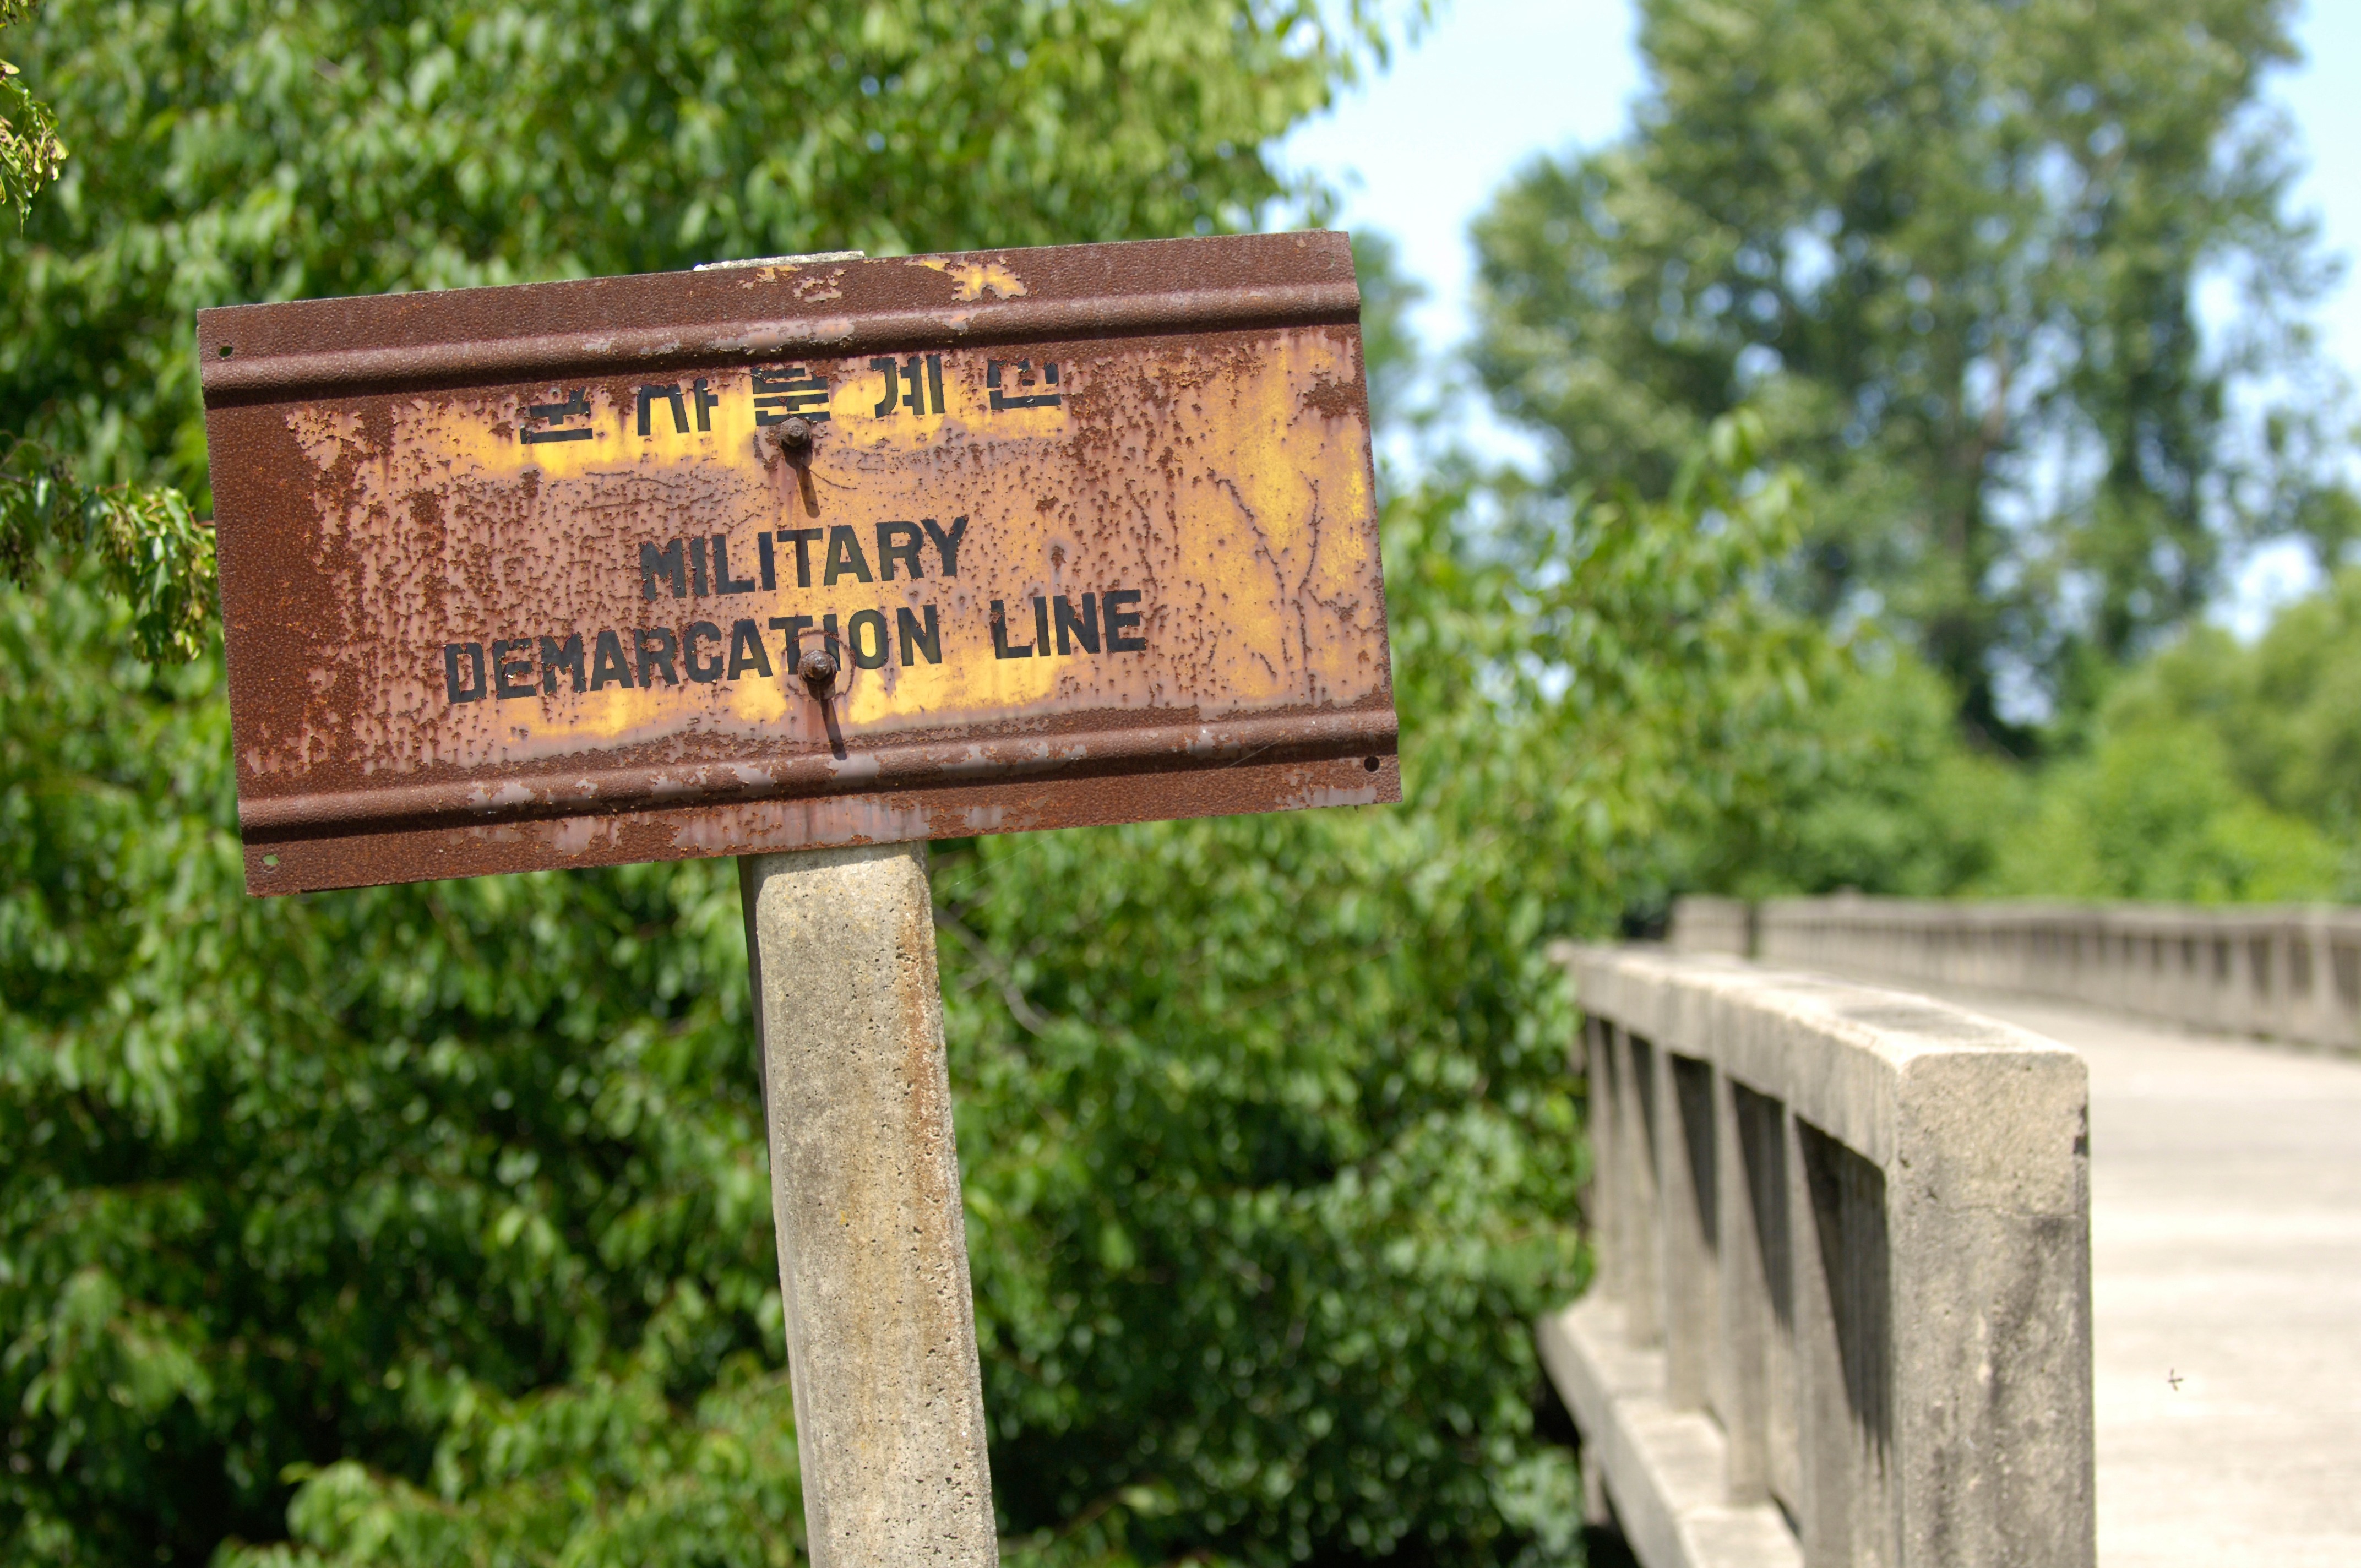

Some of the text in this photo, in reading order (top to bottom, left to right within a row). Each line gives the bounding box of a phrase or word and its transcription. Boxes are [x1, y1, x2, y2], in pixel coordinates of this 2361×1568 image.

[638, 516, 970, 602] MILITARY
[443, 589, 1147, 704] DEMARCATION LINE
